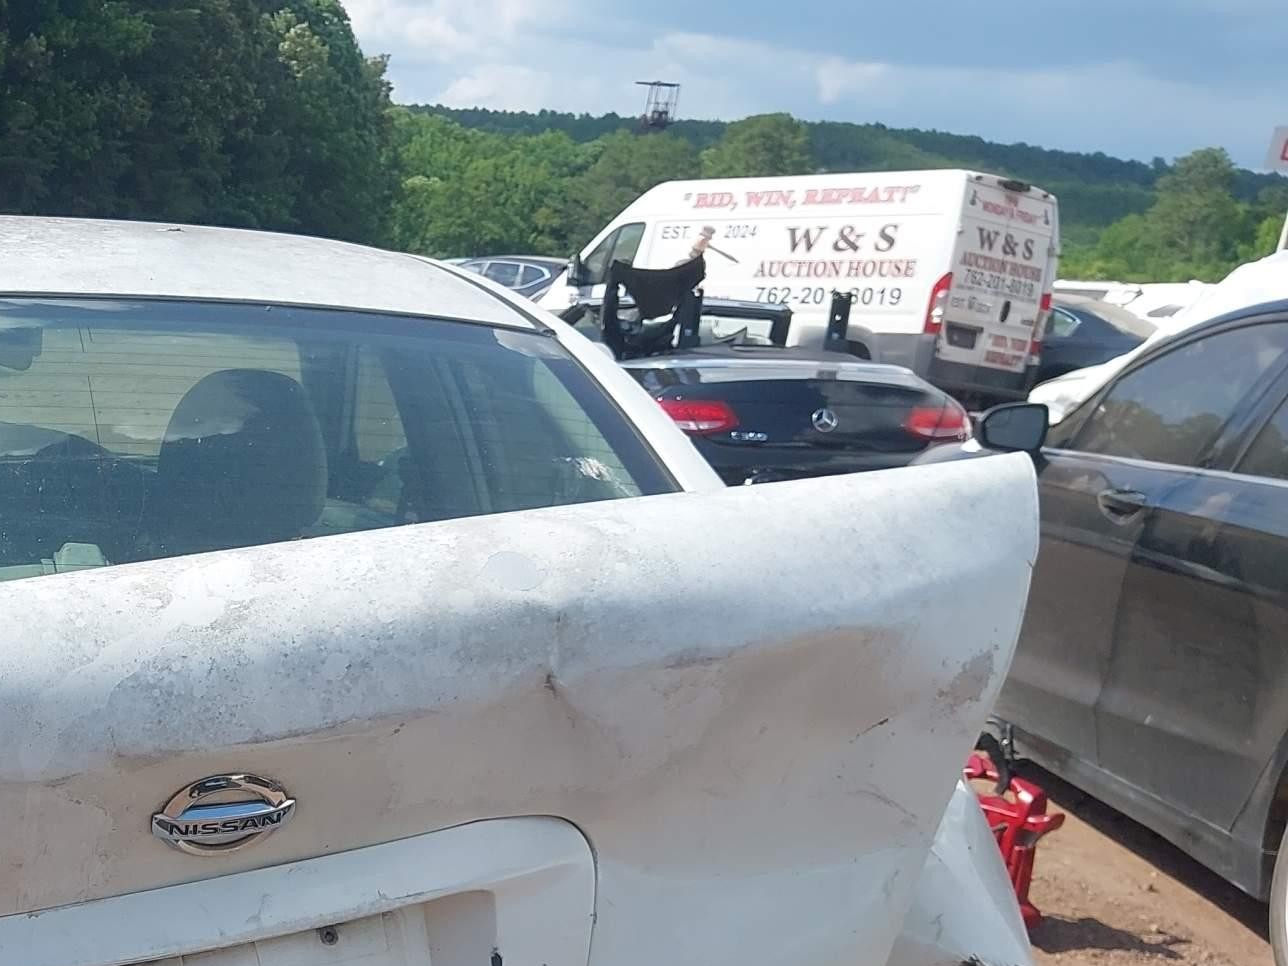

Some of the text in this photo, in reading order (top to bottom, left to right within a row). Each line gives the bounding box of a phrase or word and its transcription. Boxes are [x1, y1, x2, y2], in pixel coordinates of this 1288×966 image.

[745, 190, 797, 209] WIN,
[661, 225, 758, 240] EST. 2024
[785, 224, 901, 253] W & S
[976, 226, 1035, 260] W & S
[754, 258, 917, 279] AUCTION HOUSE
[169, 811, 283, 836] NISSAN
